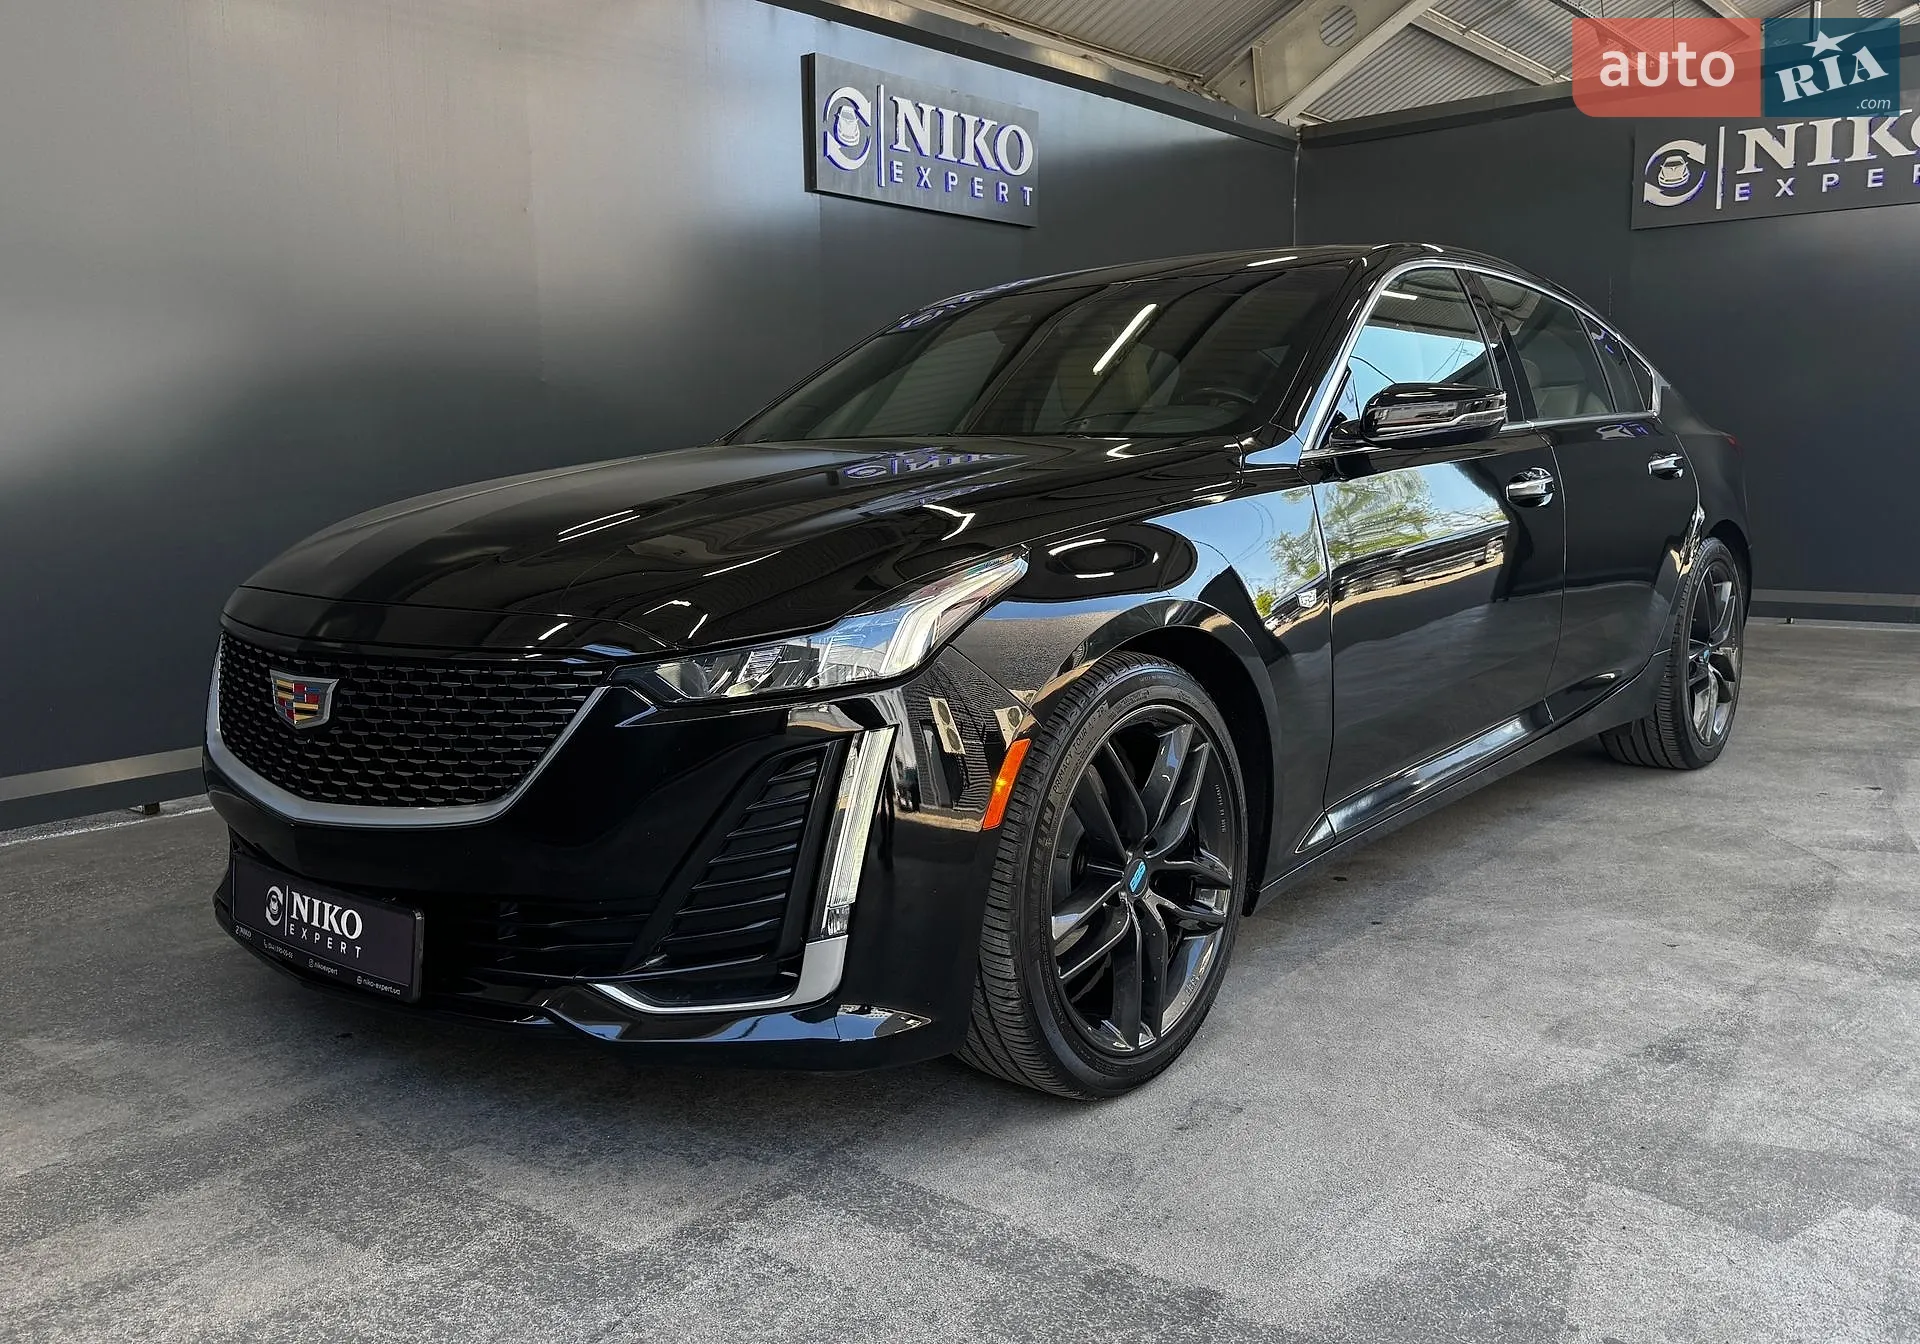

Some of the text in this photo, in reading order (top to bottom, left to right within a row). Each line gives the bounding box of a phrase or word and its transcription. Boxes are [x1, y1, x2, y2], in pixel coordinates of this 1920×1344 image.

[889, 96, 1034, 176] NIKO
[1736, 109, 1920, 174] NIK
[889, 160, 1033, 206] EXPERT
[291, 890, 363, 940] NIKO
[289, 923, 362, 959] EXPERT
